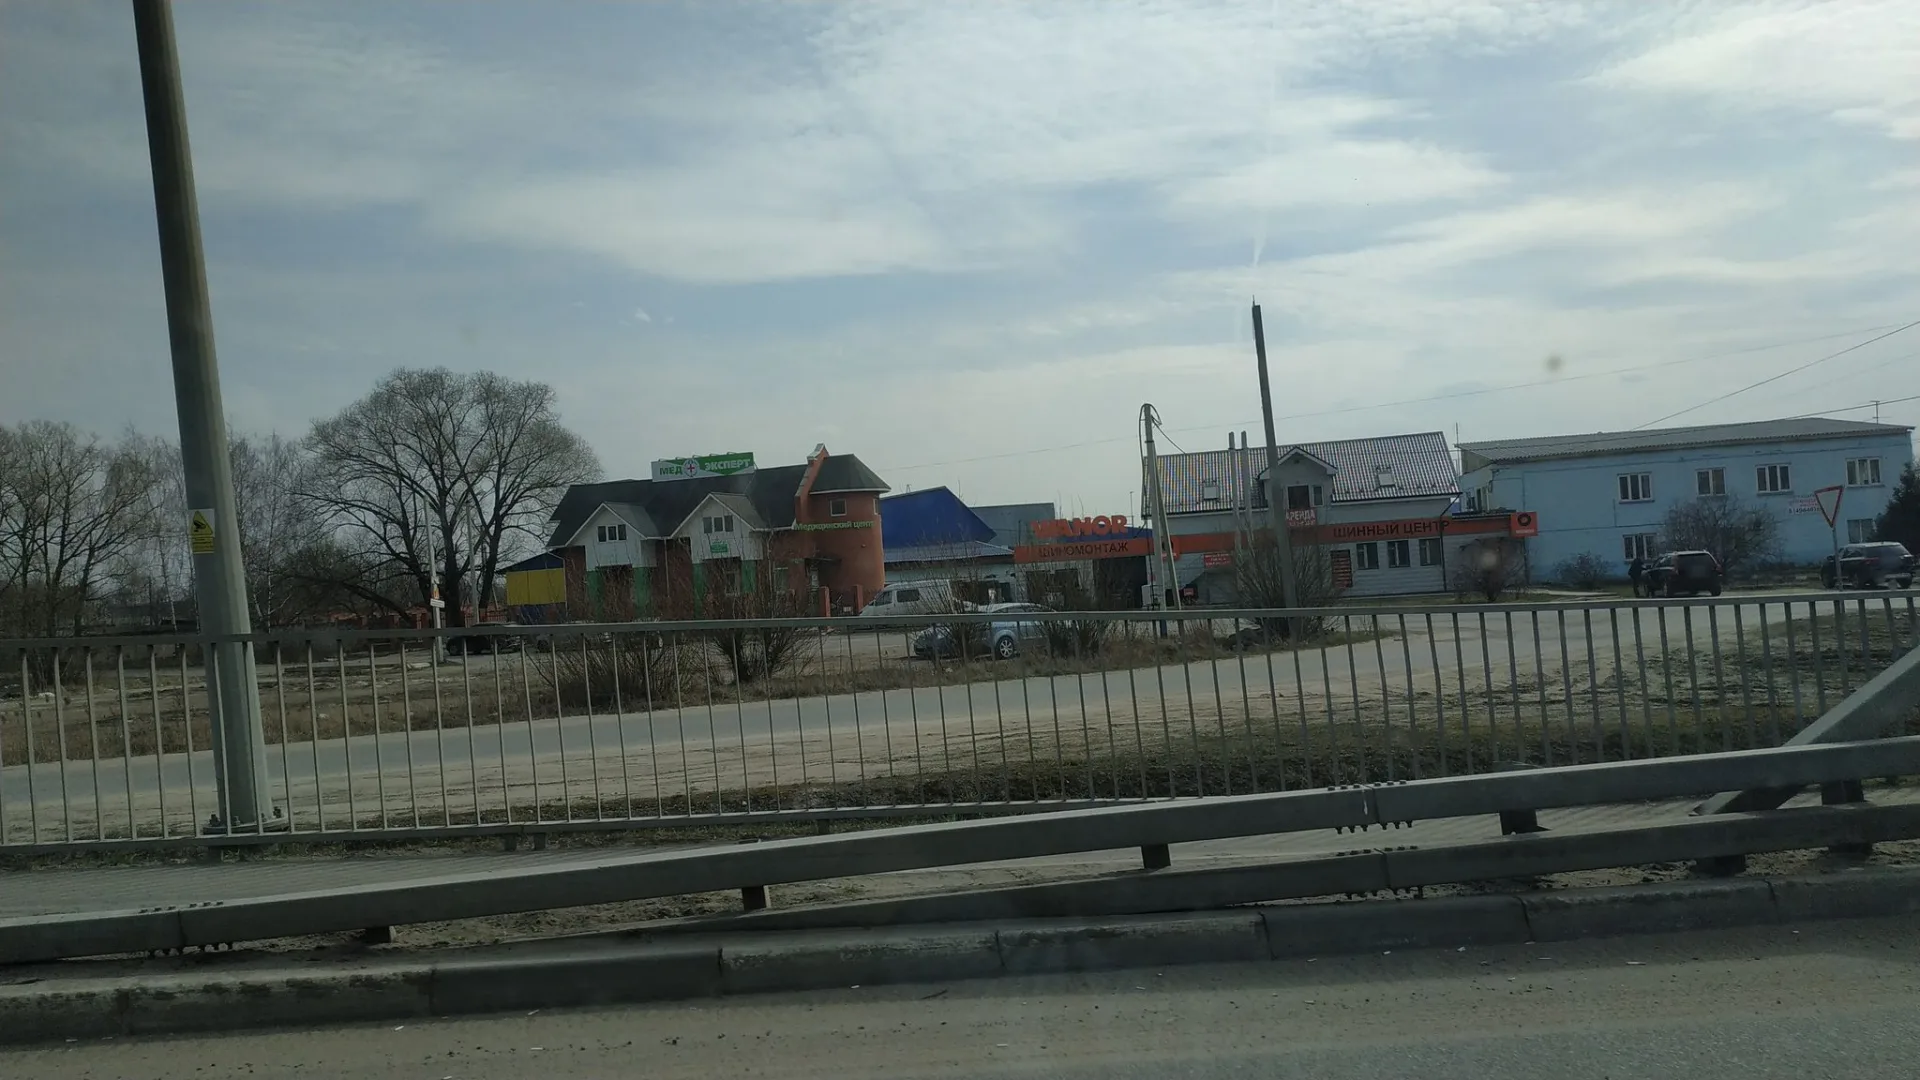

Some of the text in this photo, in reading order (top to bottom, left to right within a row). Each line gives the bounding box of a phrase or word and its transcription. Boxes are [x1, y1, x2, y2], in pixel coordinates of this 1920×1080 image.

[659, 459, 751, 476] МЕД ЭКСПЕРТ
[1333, 522, 1399, 538] ШИННЫЙ
[1403, 520, 1450, 535] ЦЕНТР
[1038, 542, 1129, 558] ШИНОМОНТАЖ
